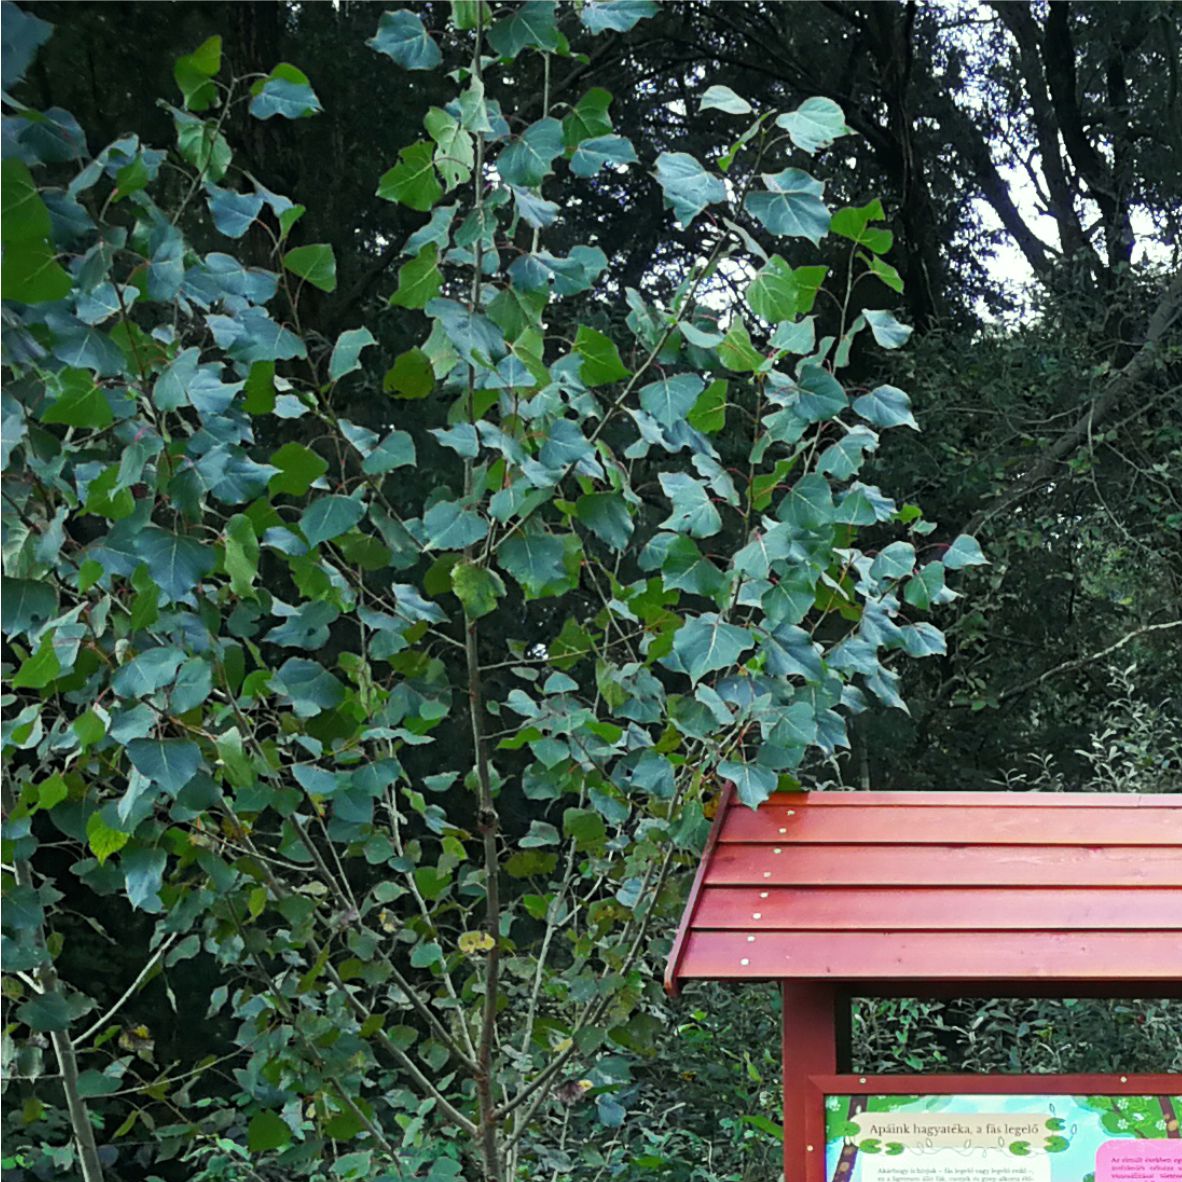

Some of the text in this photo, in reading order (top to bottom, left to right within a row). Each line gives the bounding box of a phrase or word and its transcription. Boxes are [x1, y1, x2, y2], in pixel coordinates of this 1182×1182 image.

[870, 1123, 1039, 1137] Apáink hagyatéka, a fás legelő
